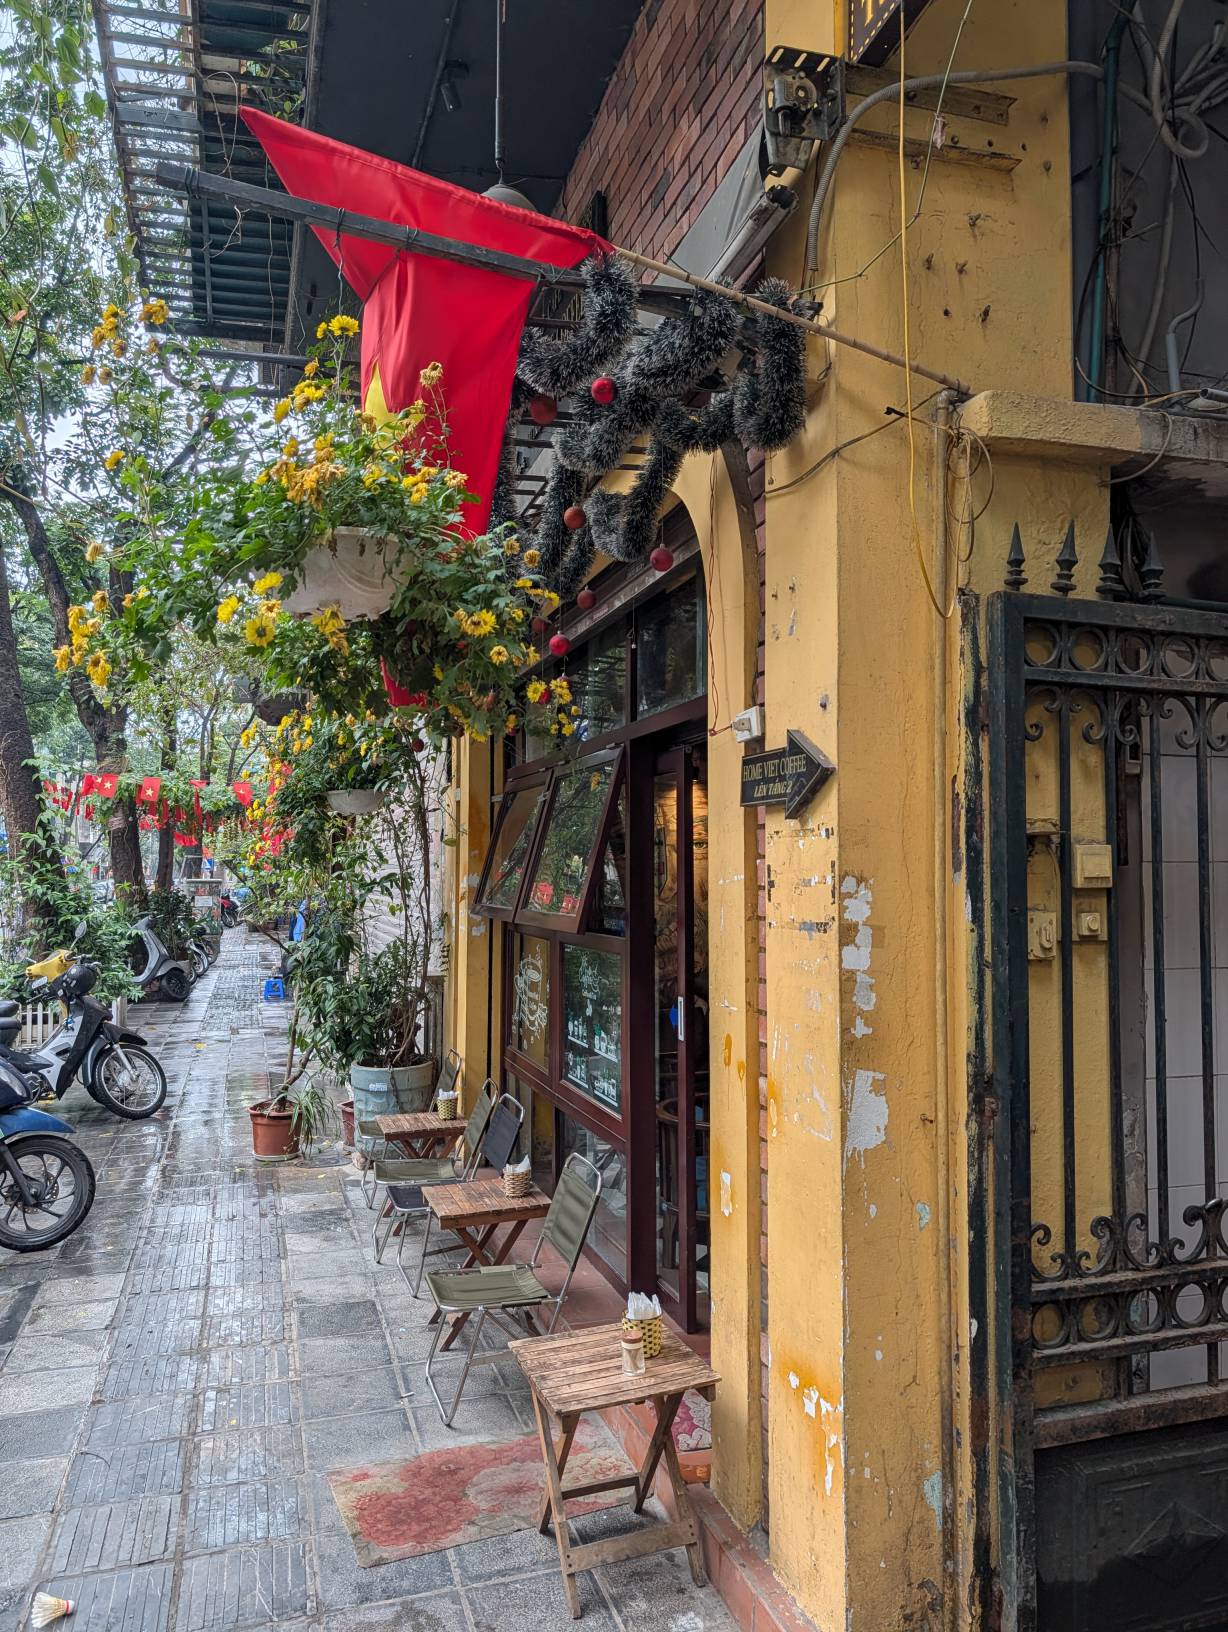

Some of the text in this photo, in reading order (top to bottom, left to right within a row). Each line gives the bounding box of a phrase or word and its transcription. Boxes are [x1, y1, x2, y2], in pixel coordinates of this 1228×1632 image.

[743, 763, 763, 781] HOME
[780, 754, 806, 775] COFFEE
[786, 781, 793, 793] 2
